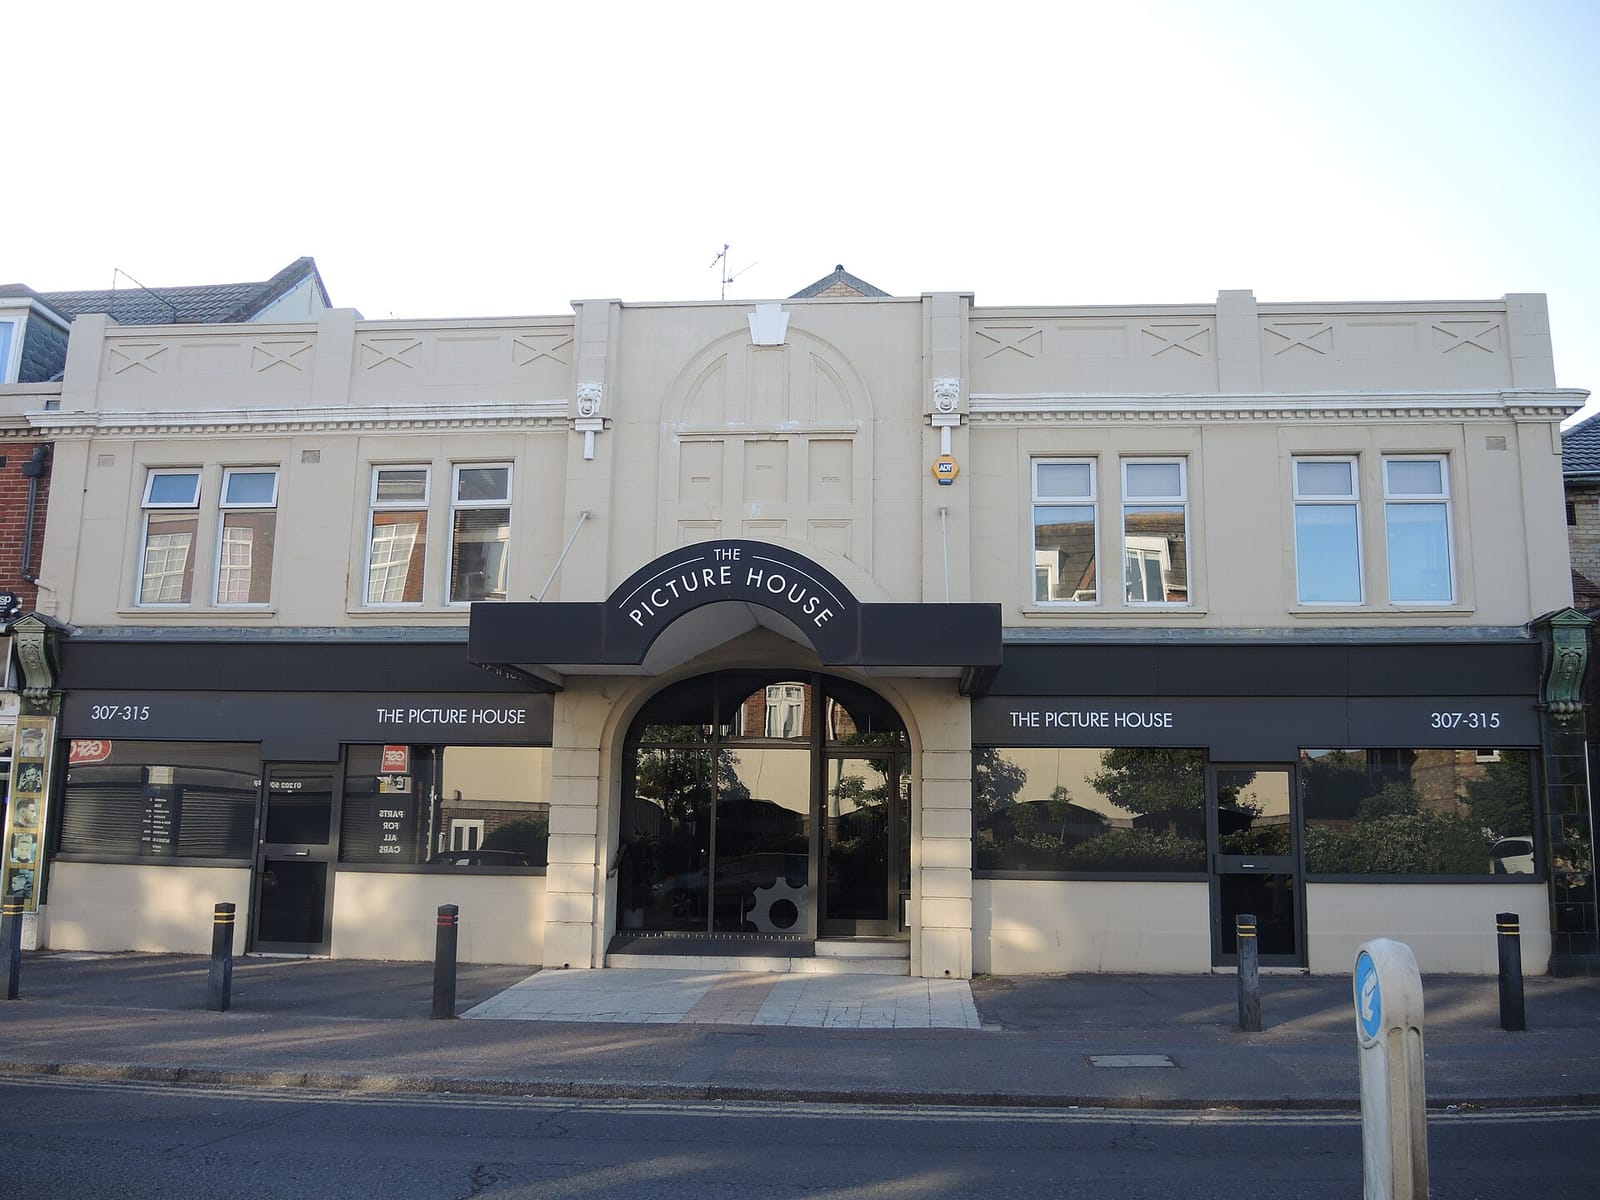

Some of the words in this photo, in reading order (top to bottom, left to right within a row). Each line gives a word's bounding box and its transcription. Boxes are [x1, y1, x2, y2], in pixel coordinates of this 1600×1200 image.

[938, 464, 953, 472] ADT
[714, 548, 741, 561] THE
[629, 566, 731, 627] PICTURE
[746, 567, 834, 627] HOUSE
[91, 705, 150, 721] 307-315
[377, 709, 405, 723] THE
[408, 709, 468, 724] PICTURE
[472, 709, 526, 724] HOUSE
[1009, 712, 1040, 727] THE
[1045, 712, 1109, 728] PICTURE
[1114, 712, 1173, 728] HOUSE
[1431, 712, 1500, 728] 307-315
